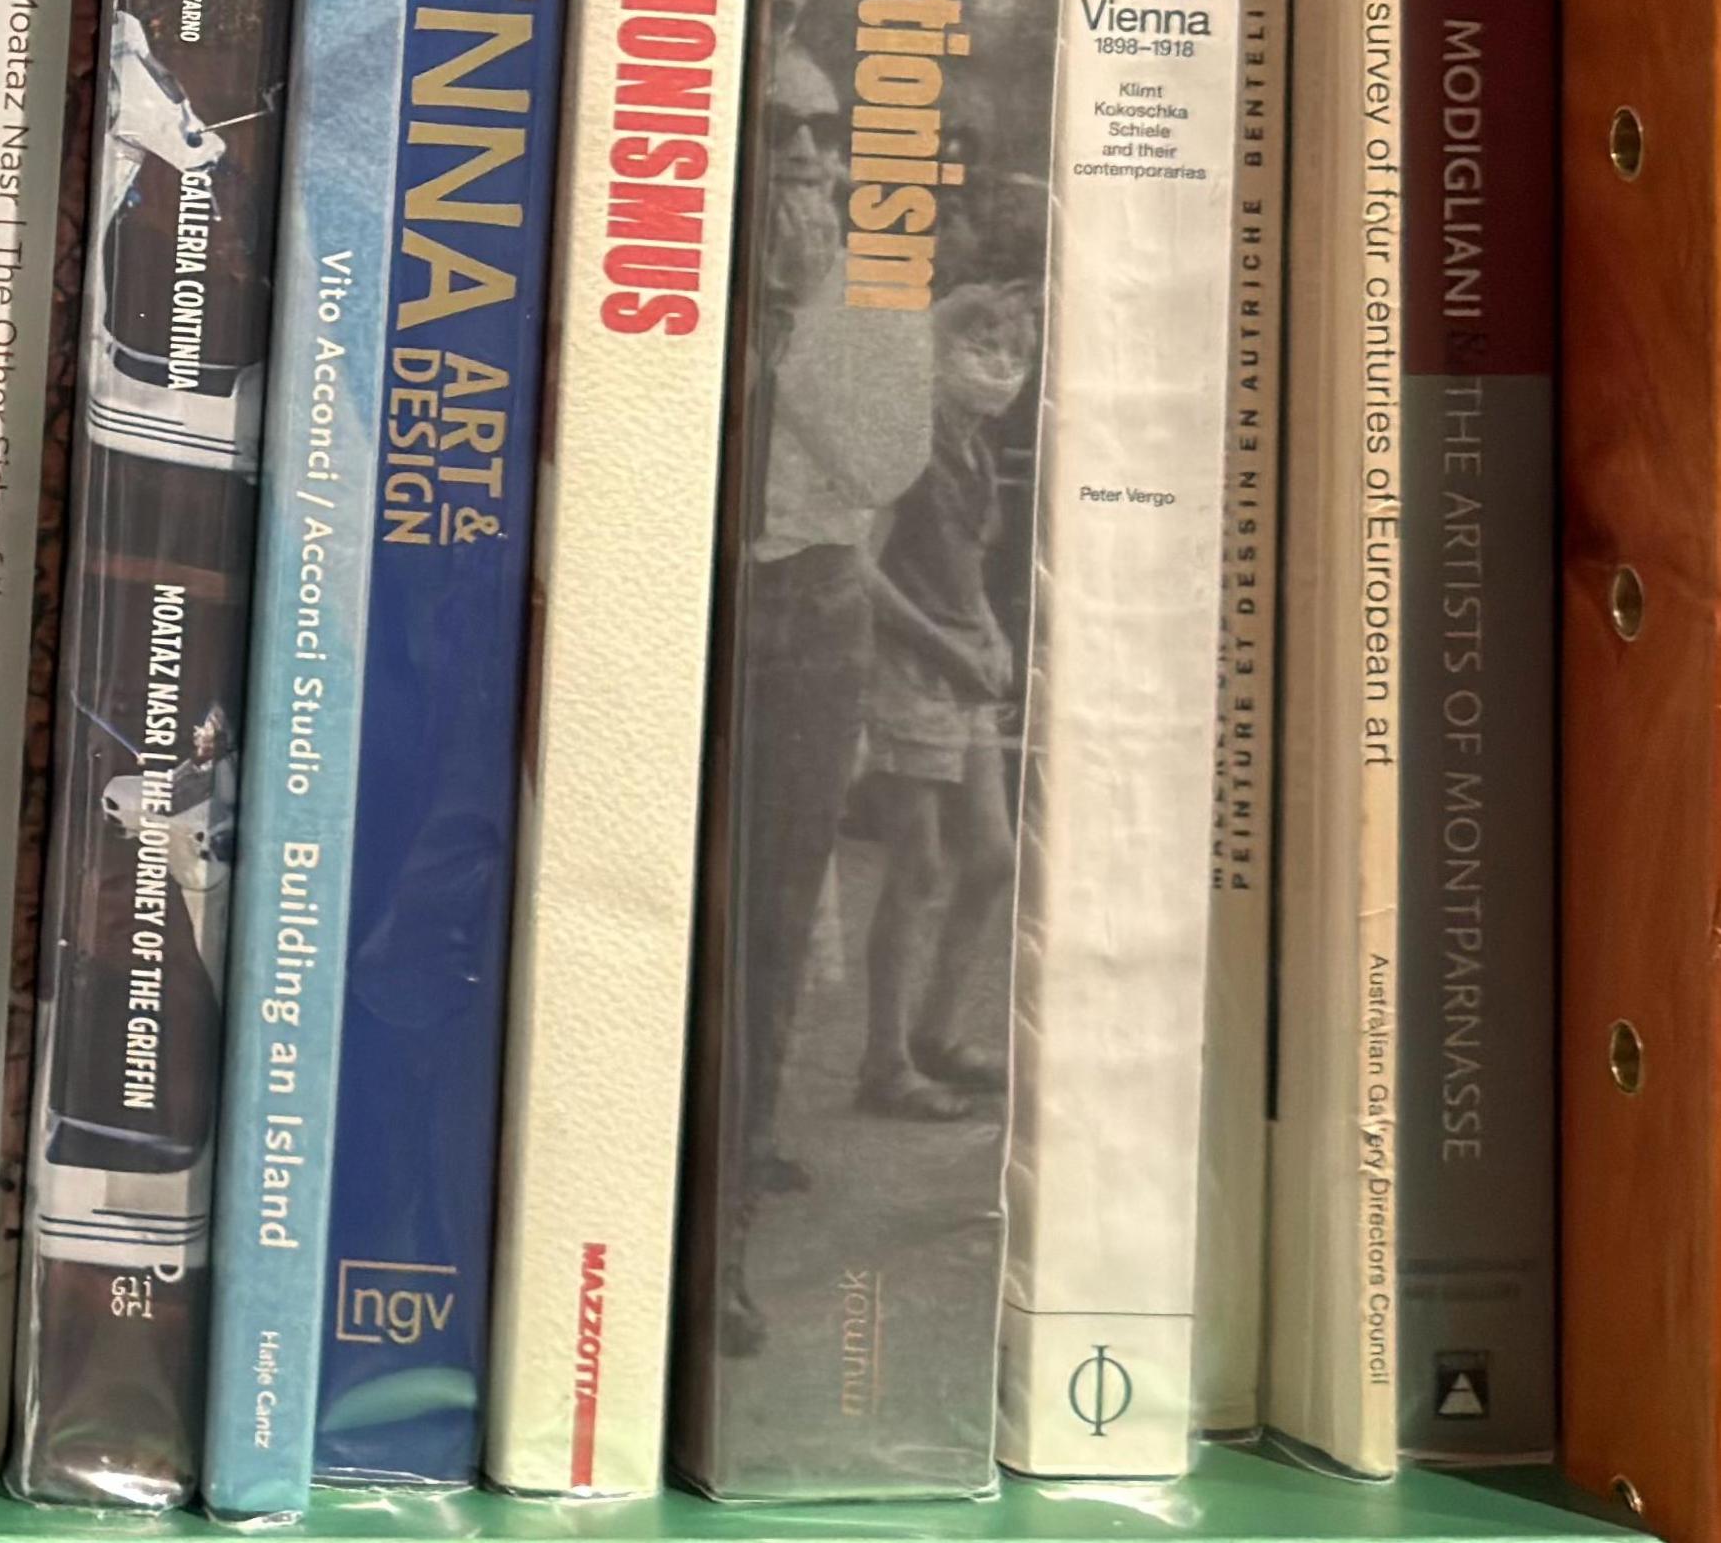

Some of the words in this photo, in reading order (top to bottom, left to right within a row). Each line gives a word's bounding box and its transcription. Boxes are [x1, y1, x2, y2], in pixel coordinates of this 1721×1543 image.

[1083, 0, 1212, 37] Vienna
[1094, 102, 1189, 121] Kokoschka
[1109, 122, 1172, 140] Schiele
[1118, 81, 1164, 100] Klimt
[1444, 21, 1483, 317] MODIGLIANI
[175, 171, 212, 274] GALLERIA
[168, 280, 205, 389] CONTINUA
[383, 348, 441, 544] DESIGN
[438, 351, 509, 498] ART
[1444, 376, 1483, 475] THE
[455, 507, 499, 543] &
[1080, 486, 1122, 503] Peter
[1125, 488, 1176, 508] Vergo
[1445, 493, 1482, 673] ARTISTS
[149, 584, 185, 678] MOATAZ
[145, 683, 179, 747] NASR
[1446, 692, 1482, 751] OF
[140, 769, 173, 813] THE
[135, 816, 170, 926] JOURNEY
[131, 930, 164, 962] OF
[262, 844, 320, 1026] Building
[1444, 773, 1482, 1161] MONTPARNASSE
[129, 967, 162, 1011] THE
[123, 1017, 158, 1109] GRIFFIN
[270, 1044, 298, 1093] an
[261, 1117, 305, 1248] Island
[354, 1290, 454, 1344] ngv
[573, 1243, 607, 1401] MAZZOTTA
